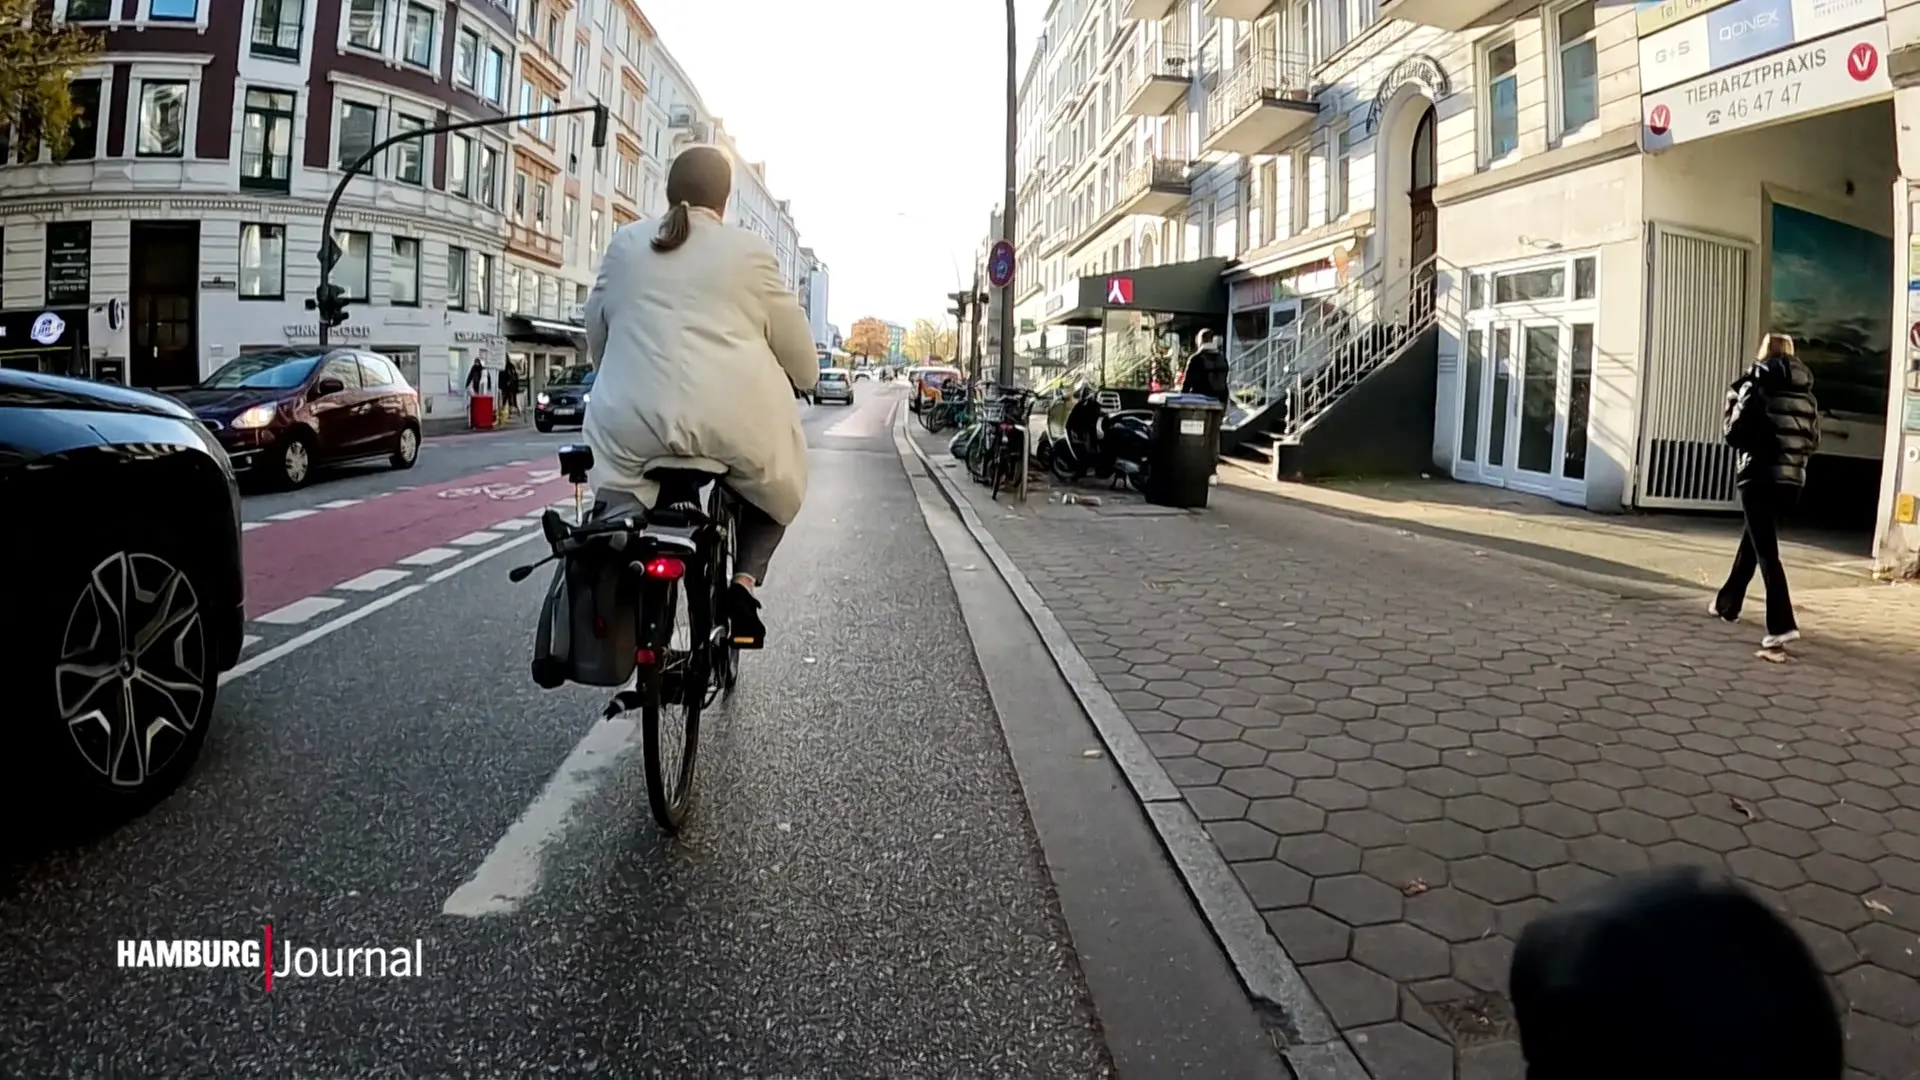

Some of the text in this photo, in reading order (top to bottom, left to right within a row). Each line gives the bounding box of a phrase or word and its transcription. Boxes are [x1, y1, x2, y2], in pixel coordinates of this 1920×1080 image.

[1684, 48, 1827, 106] TIERARZTPRAXIS
[1727, 82, 1803, 119] 46 47 47
[283, 325, 370, 338] CINNMOOD
